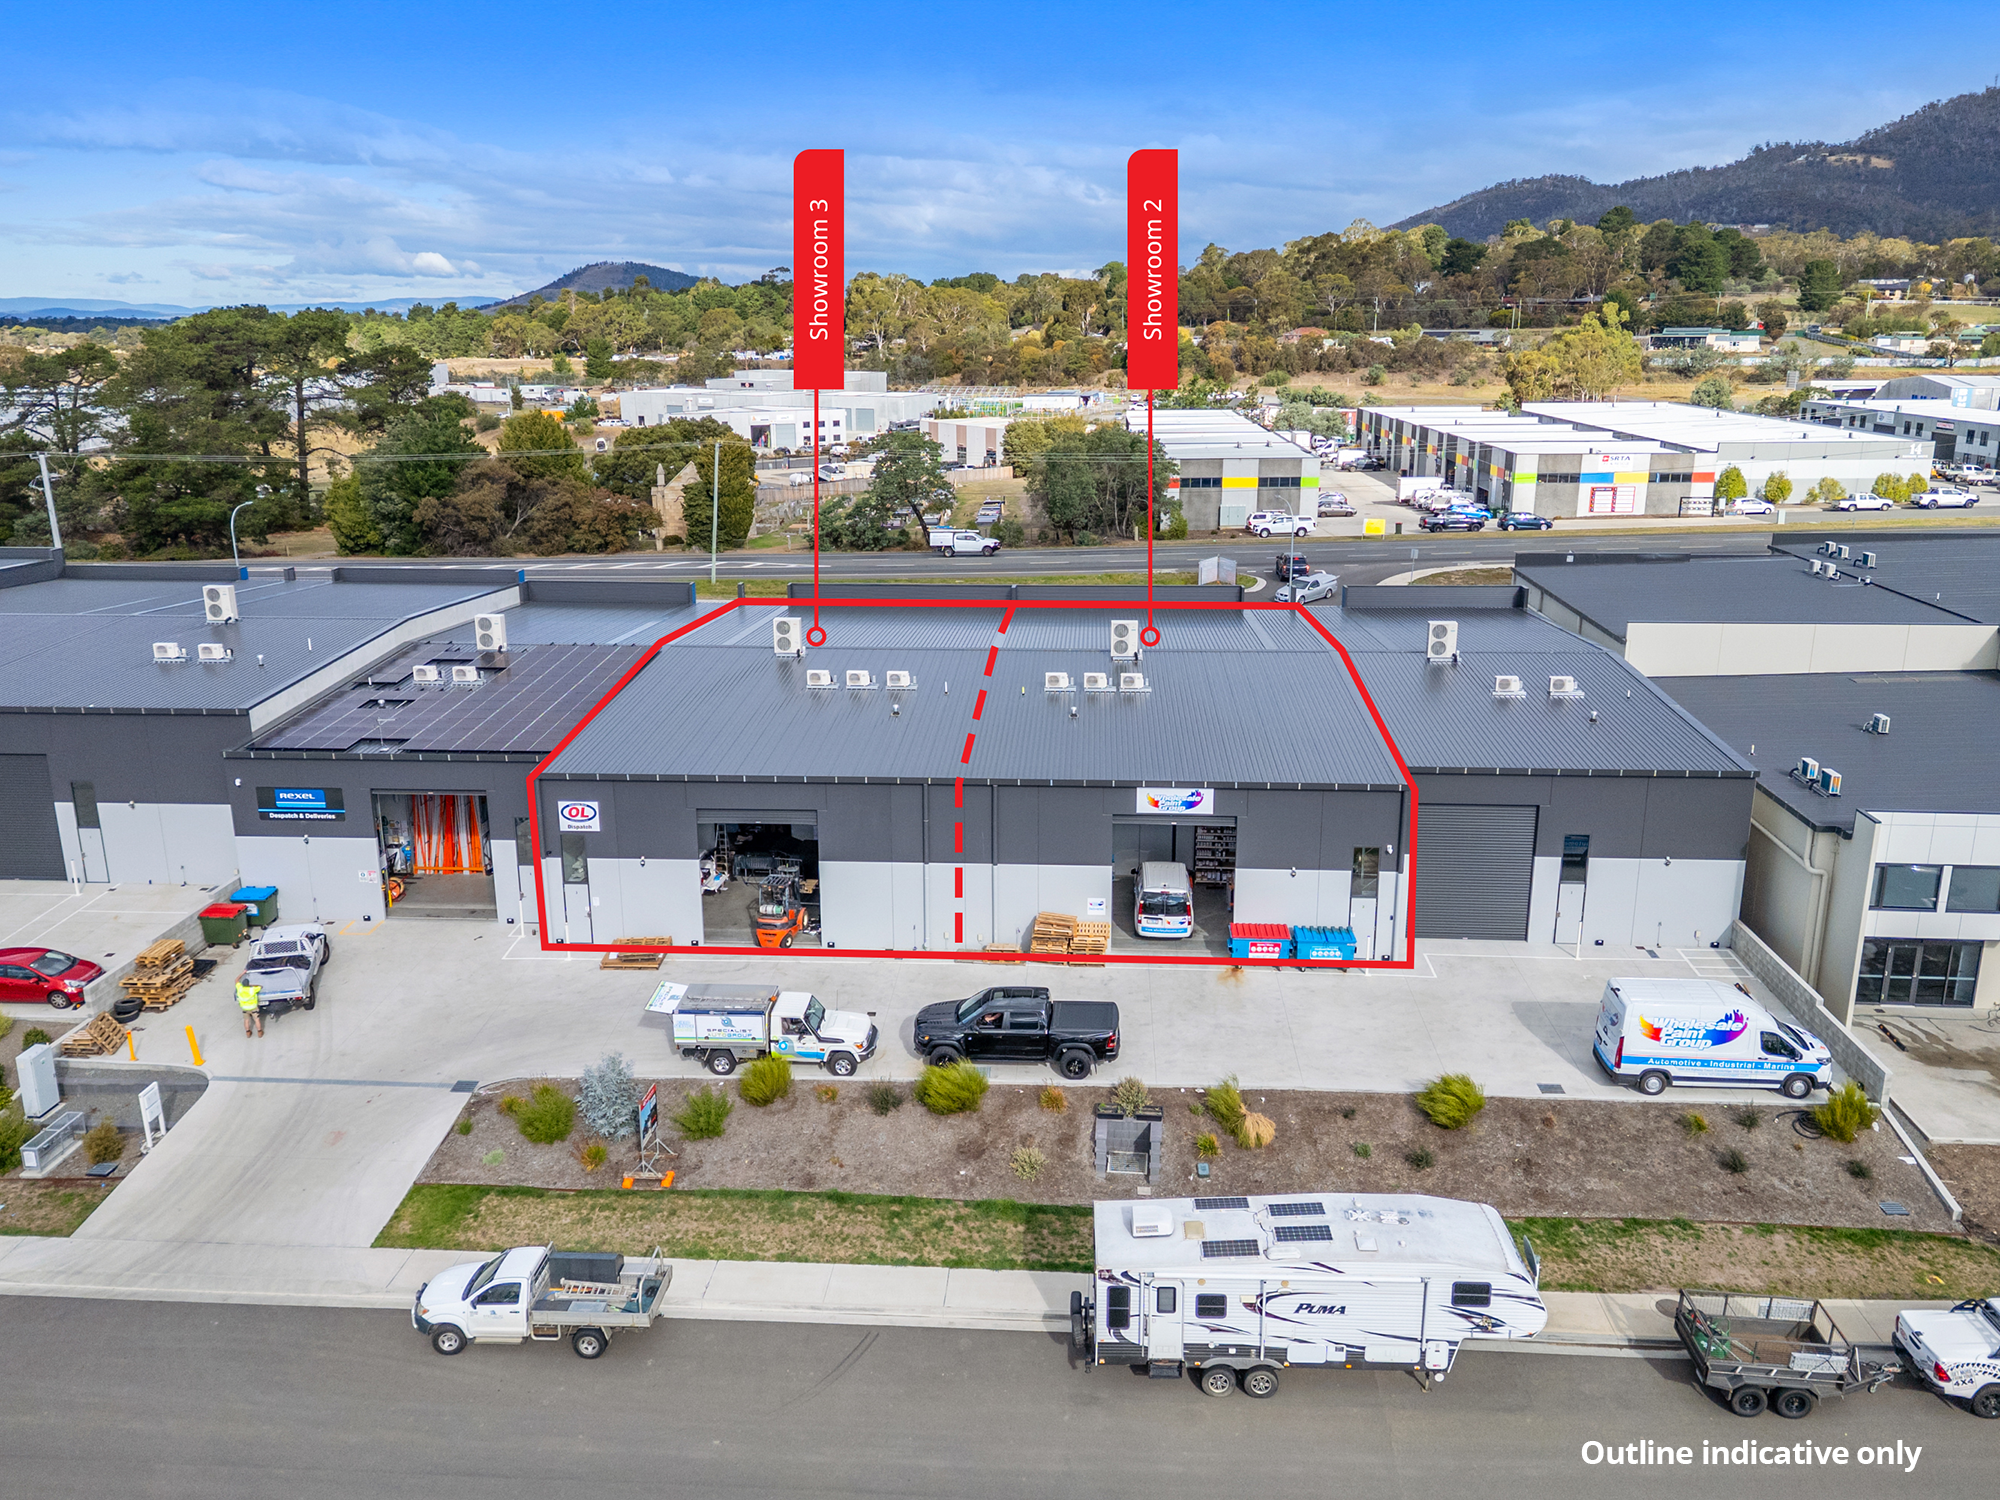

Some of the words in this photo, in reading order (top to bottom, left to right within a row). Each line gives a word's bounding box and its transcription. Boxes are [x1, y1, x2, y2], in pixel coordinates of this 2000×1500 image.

[1909, 443, 1923, 455] 14
[568, 806, 590, 818] OL
[1158, 805, 1186, 813] Group
[269, 812, 299, 820] Despatch
[1653, 1016, 1744, 1031] Wholesale
[1658, 1027, 1707, 1039] Paint
[1659, 1037, 1713, 1051] Group
[1647, 1057, 1701, 1067] Automotive
[1709, 1060, 1756, 1069] Industrial
[1763, 1062, 1796, 1071] Marine
[1293, 1303, 1347, 1315] PUMA
